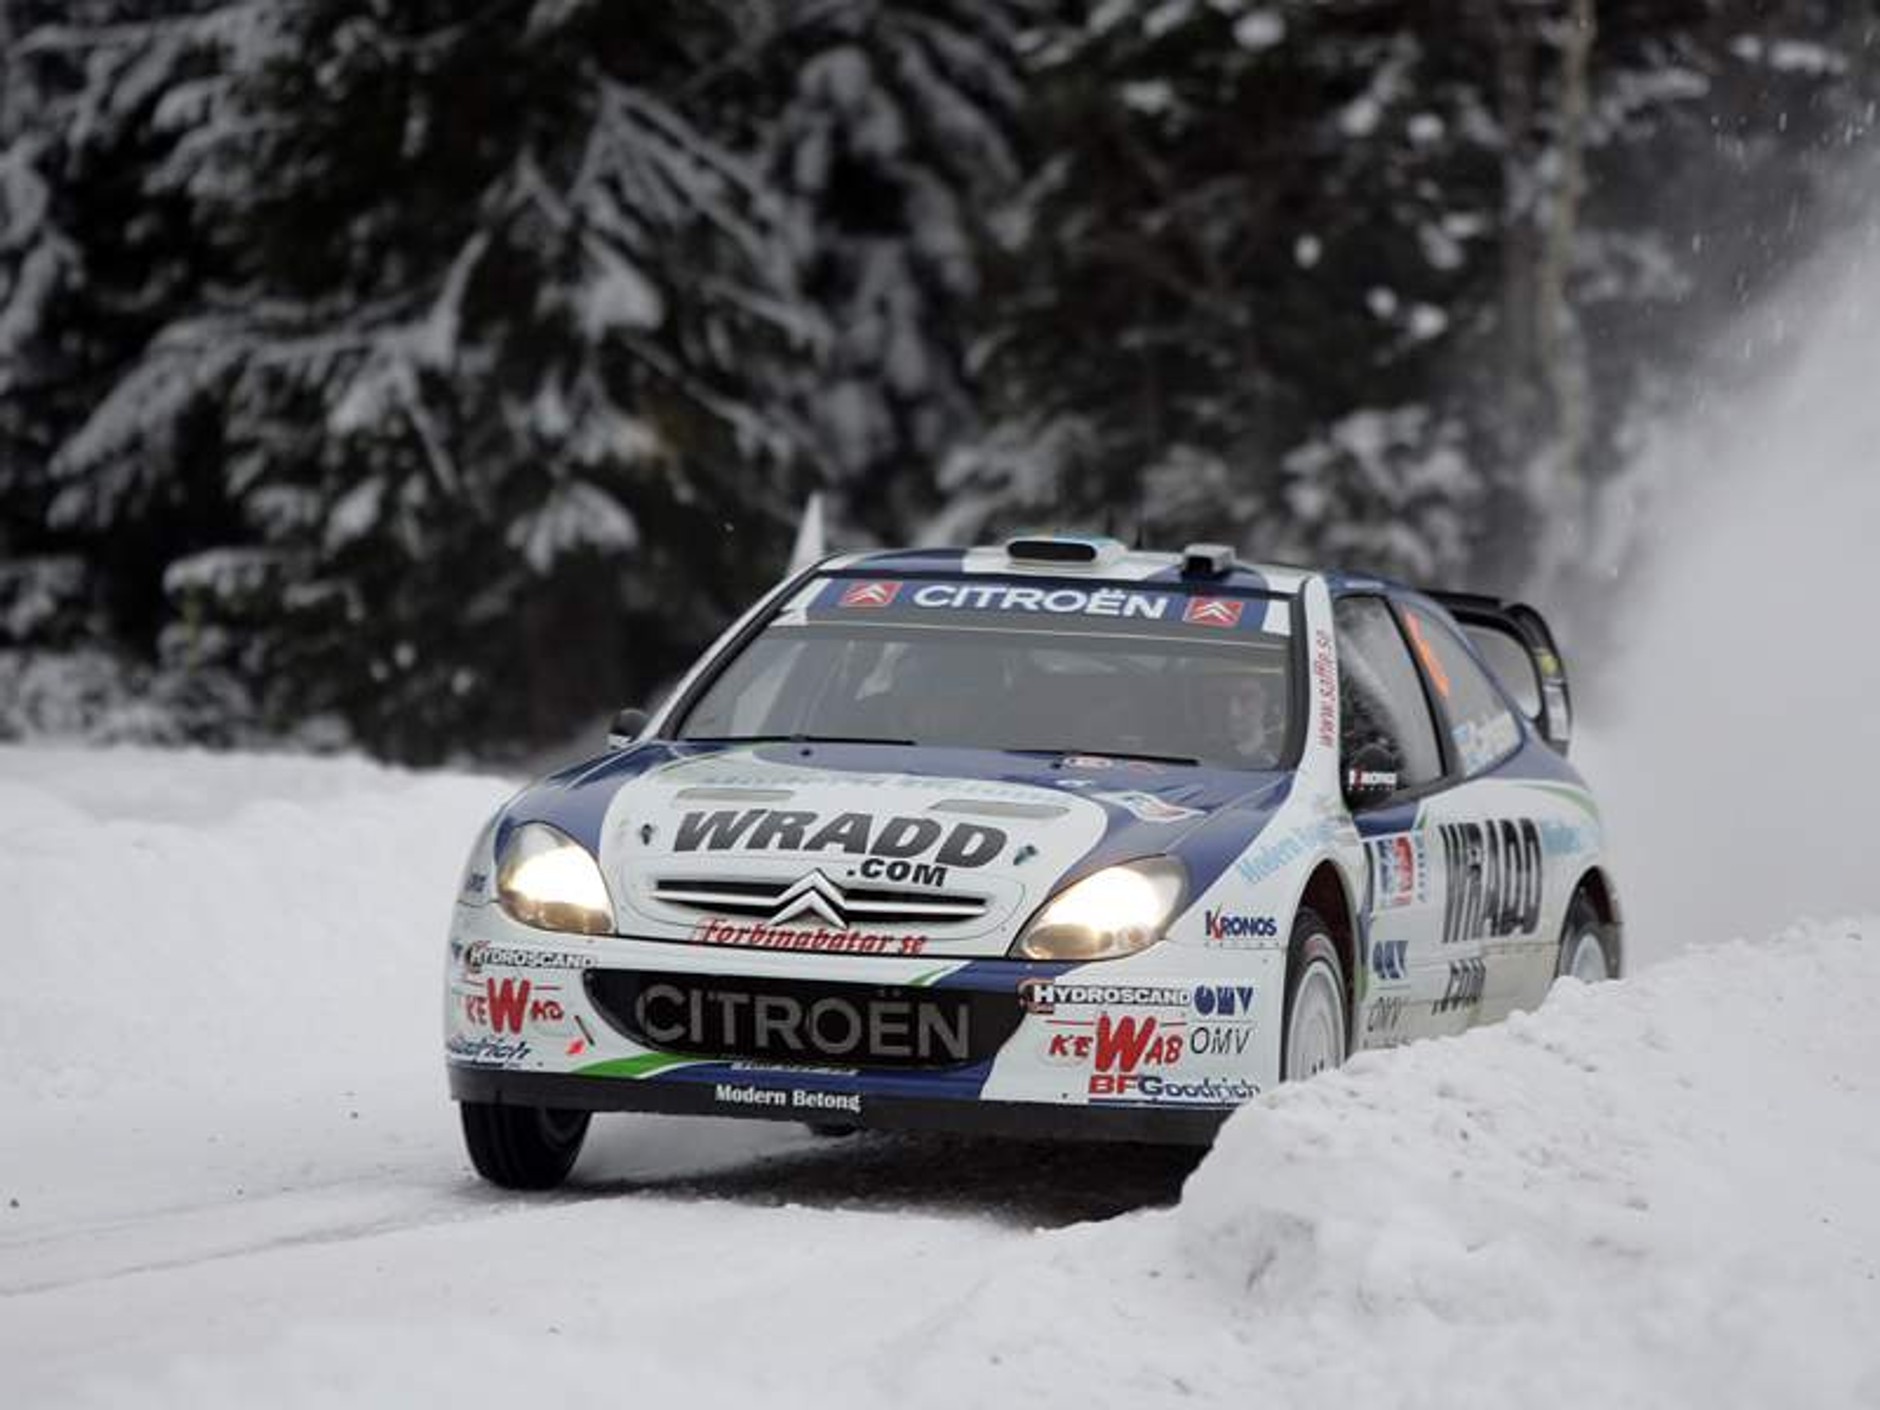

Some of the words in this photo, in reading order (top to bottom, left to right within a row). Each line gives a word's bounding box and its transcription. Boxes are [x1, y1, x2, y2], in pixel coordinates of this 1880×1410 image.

[912, 581, 1168, 620] CITROËN
[671, 807, 1008, 868] WRADD
[846, 856, 948, 888] .COM
[1437, 817, 1543, 943] WRADD
[1204, 906, 1278, 940] KRONOS
[469, 948, 597, 970] HYDROSCAND
[1034, 984, 1191, 1006] HYDROSCAND
[635, 982, 971, 1060] CITROËN
[1048, 1014, 1184, 1073] KEWAB
[715, 1084, 786, 1106] Modern
[792, 1089, 862, 1113] Betong
[1088, 1074, 1261, 1098] BFGoodrich
